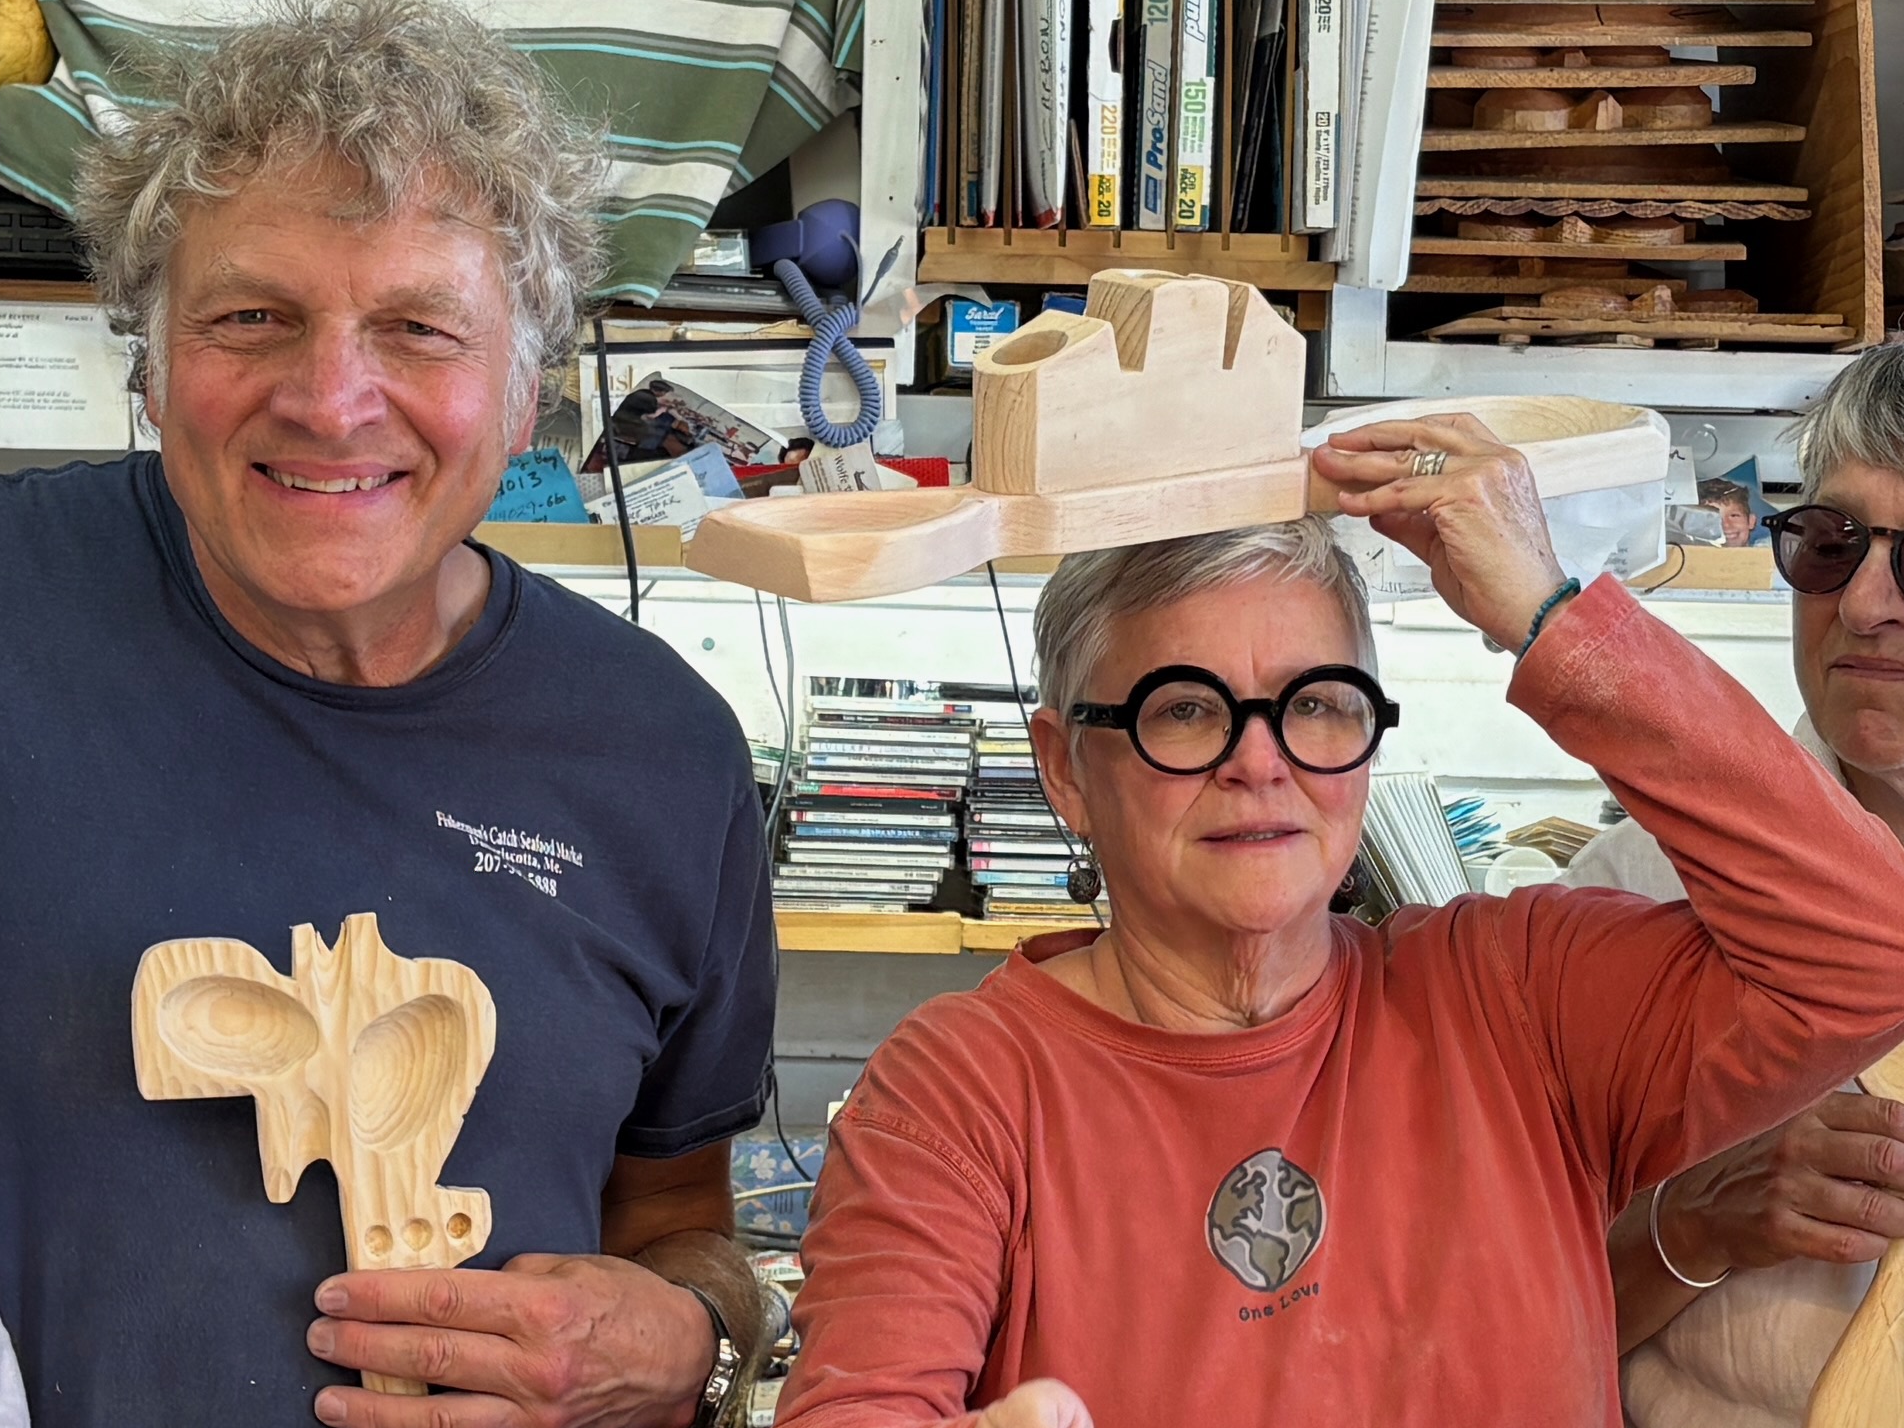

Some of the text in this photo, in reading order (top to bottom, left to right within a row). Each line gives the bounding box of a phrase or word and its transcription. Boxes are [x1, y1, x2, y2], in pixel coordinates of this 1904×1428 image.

[1183, 78, 1207, 114] 150
[1101, 104, 1117, 135] 220
[1144, 61, 1169, 171] ProSand
[1316, 112, 1330, 128] 20
[1098, 198, 1111, 218] 20
[1179, 199, 1195, 220] 20
[834, 454, 848, 485] Wolfe
[489, 826, 518, 847] Catch
[520, 830, 556, 857] Seafood
[556, 841, 584, 868] Market
[1238, 1305, 1276, 1323] One
